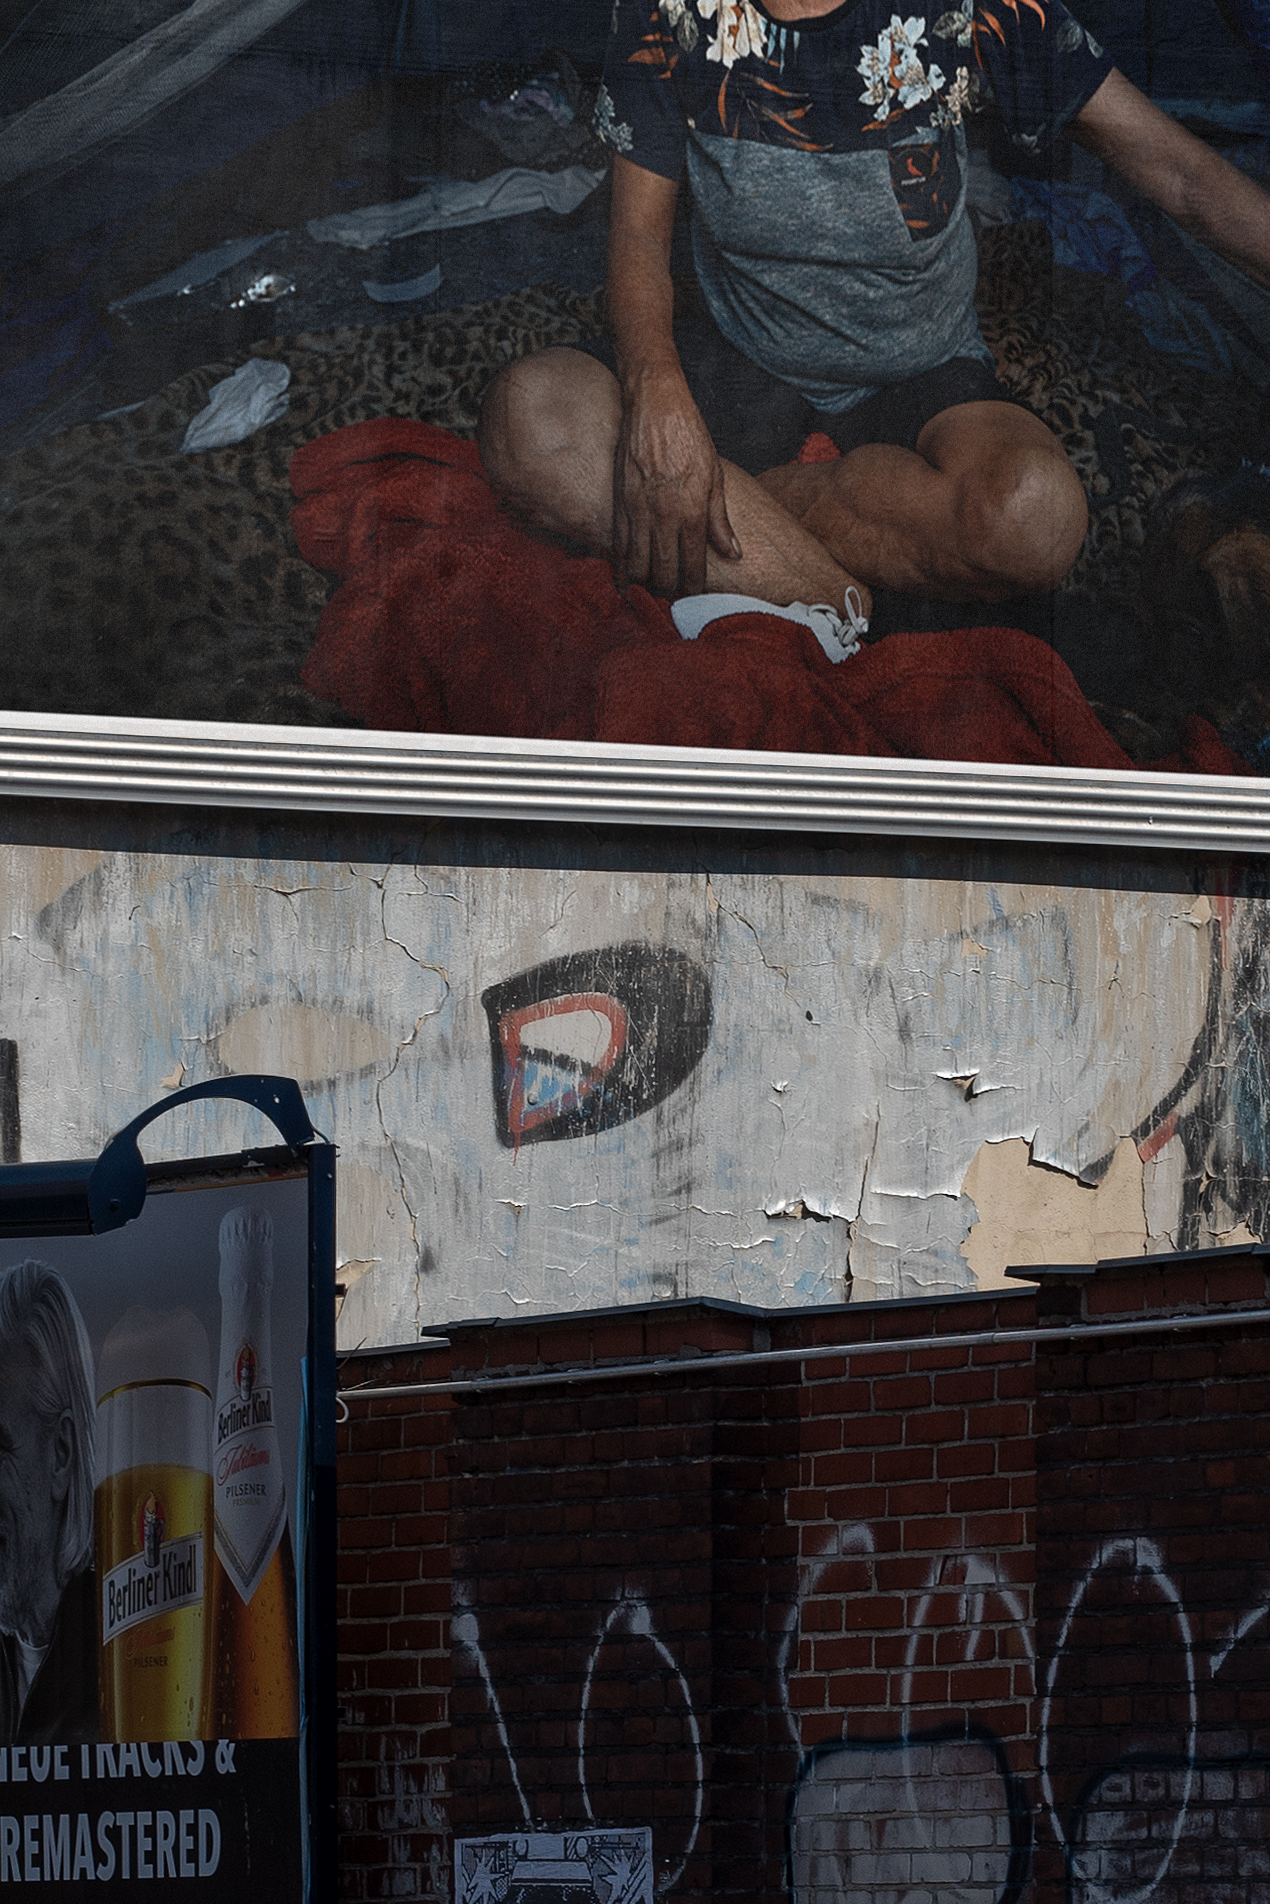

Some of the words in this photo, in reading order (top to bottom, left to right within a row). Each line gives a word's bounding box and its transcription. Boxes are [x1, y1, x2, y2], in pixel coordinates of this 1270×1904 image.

[216, 1401, 252, 1445] Berliner
[251, 1389, 273, 1426] Kindl
[225, 1483, 267, 1499] PILSENER
[107, 1567, 161, 1630] Berliner
[161, 1544, 198, 1602] Kindl
[133, 1655, 170, 1669] PILSENER
[0, 1807, 223, 1882] REMASTERED
